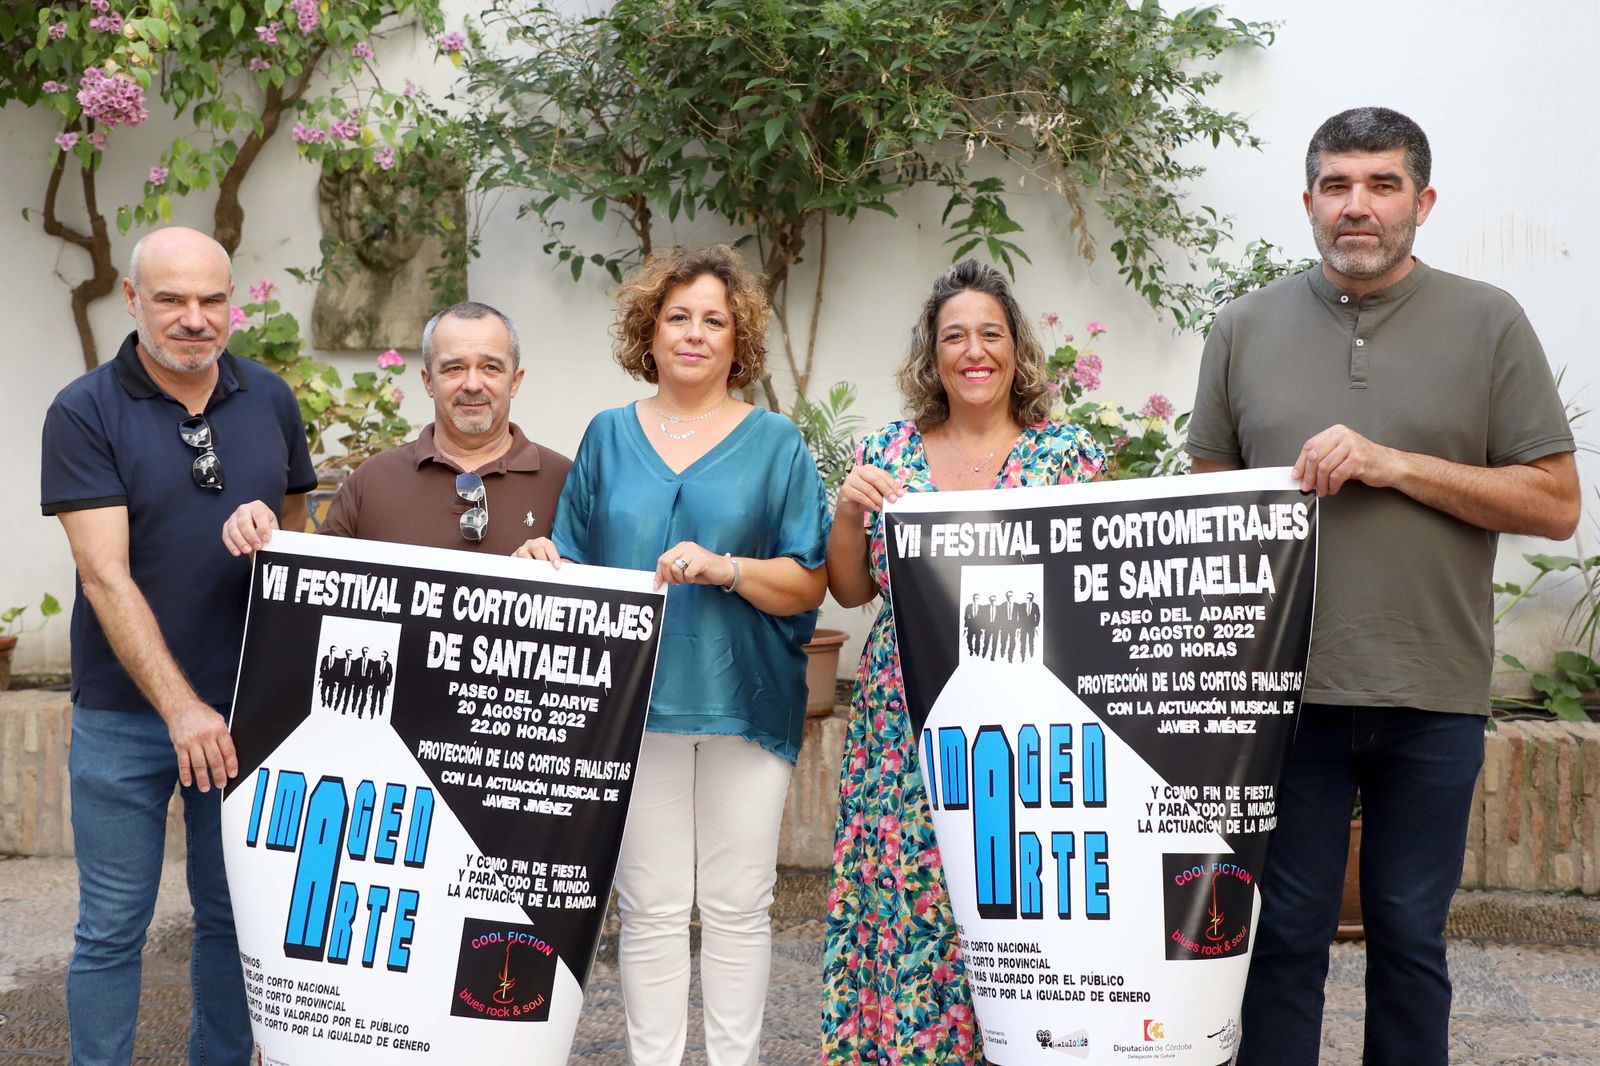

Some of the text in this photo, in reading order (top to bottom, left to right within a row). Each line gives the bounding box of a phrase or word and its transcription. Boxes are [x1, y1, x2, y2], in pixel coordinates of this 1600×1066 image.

[894, 502, 1309, 559] VII FESTIVAL DE CORTOMETRAJES
[1074, 554, 1276, 602] DE SANTAELLA
[263, 562, 654, 642] VII FESTIVAL DE CORTOMETRAJES
[1100, 605, 1266, 627] PASEO DEL ADARVE
[1112, 623, 1255, 643] 20 AGOSTO 2022
[426, 631, 612, 692] DE SANTAELLA
[1129, 642, 1237, 659] 22.00 HORAS
[1077, 667, 1302, 695] PROYECCIÓN DE LOS CORTOS FINALISTAS
[448, 681, 599, 712] PASEO DEL ADARVE
[1107, 697, 1294, 715] CON LA ACTUACIÓN MUSICAL DE
[457, 700, 586, 728] 20 AGOSTO 2022
[1157, 717, 1256, 734] JAVIER JIMÉNEZ
[470, 719, 567, 743] 22.00 HORAS
[417, 740, 631, 780] PROYECCIÓN DE LOS CORTOS FINALISTAS
[441, 771, 619, 801] CON LA ACTUACIÓN MUSICAL DE
[1151, 785, 1274, 800] Y COMO FIN DE FIESTA
[482, 794, 573, 816] JAVIER JIMÉNEZ
[1146, 801, 1275, 817] Y PARA TODO EL MUNDO
[1138, 819, 1153, 833] LA
[1158, 816, 1222, 833] ACTUACIÓN
[1226, 820, 1240, 833] DE
[1244, 820, 1256, 833] LA
[466, 854, 587, 879] Y COMO FIN DE FIESTA
[1175, 863, 1253, 886] COOL FICTION
[459, 869, 590, 894] Y PARA TODO EL MUNDO
[448, 884, 596, 909] LA ACTUACIÓN DE LA BANDA
[471, 931, 554, 956] COOL FICTION
[971, 941, 994, 953] CORTO
[997, 942, 1042, 954] NACIONAL
[1171, 925, 1248, 955] blues rock & soul
[972, 956, 995, 968] CORTO
[998, 957, 1051, 969] PROVINCIAL
[267, 976, 294, 990] CORTO
[297, 982, 340, 996] NACIONAL
[974, 969, 987, 983] MÁS
[989, 972, 1034, 985] VALORADO
[1038, 974, 1058, 985] POR
[1064, 975, 1075, 985] EL
[1080, 971, 1124, 986] PÚBLICO
[266, 990, 292, 1003] CORTO
[296, 996, 346, 1012] PROVINCIAL
[459, 987, 545, 1017] blues rock & soul
[977, 986, 996, 998] CORTO
[1000, 988, 1016, 1000] POR
[1020, 989, 1032, 1000] LA
[1036, 990, 1085, 1001] IGUALDAD
[1090, 991, 1104, 1002] DE
[1109, 991, 1151, 1003] GENERO
[265, 1003, 280, 1016] MÁS
[284, 1007, 329, 1024] VALORADO
[333, 1015, 351, 1027] POR
[355, 1018, 366, 1029] EL
[370, 1019, 410, 1035] PÚBLICO
[265, 1017, 289, 1032] CORTO
[291, 1025, 309, 1037] POR
[312, 1027, 324, 1038] LA
[327, 1030, 372, 1045] IGUALDAD
[376, 1036, 389, 1047] DE
[393, 1038, 431, 1052] GENERO
[1113, 1044, 1153, 1053] Diputación
[1165, 1043, 1192, 1051] Córdoba
